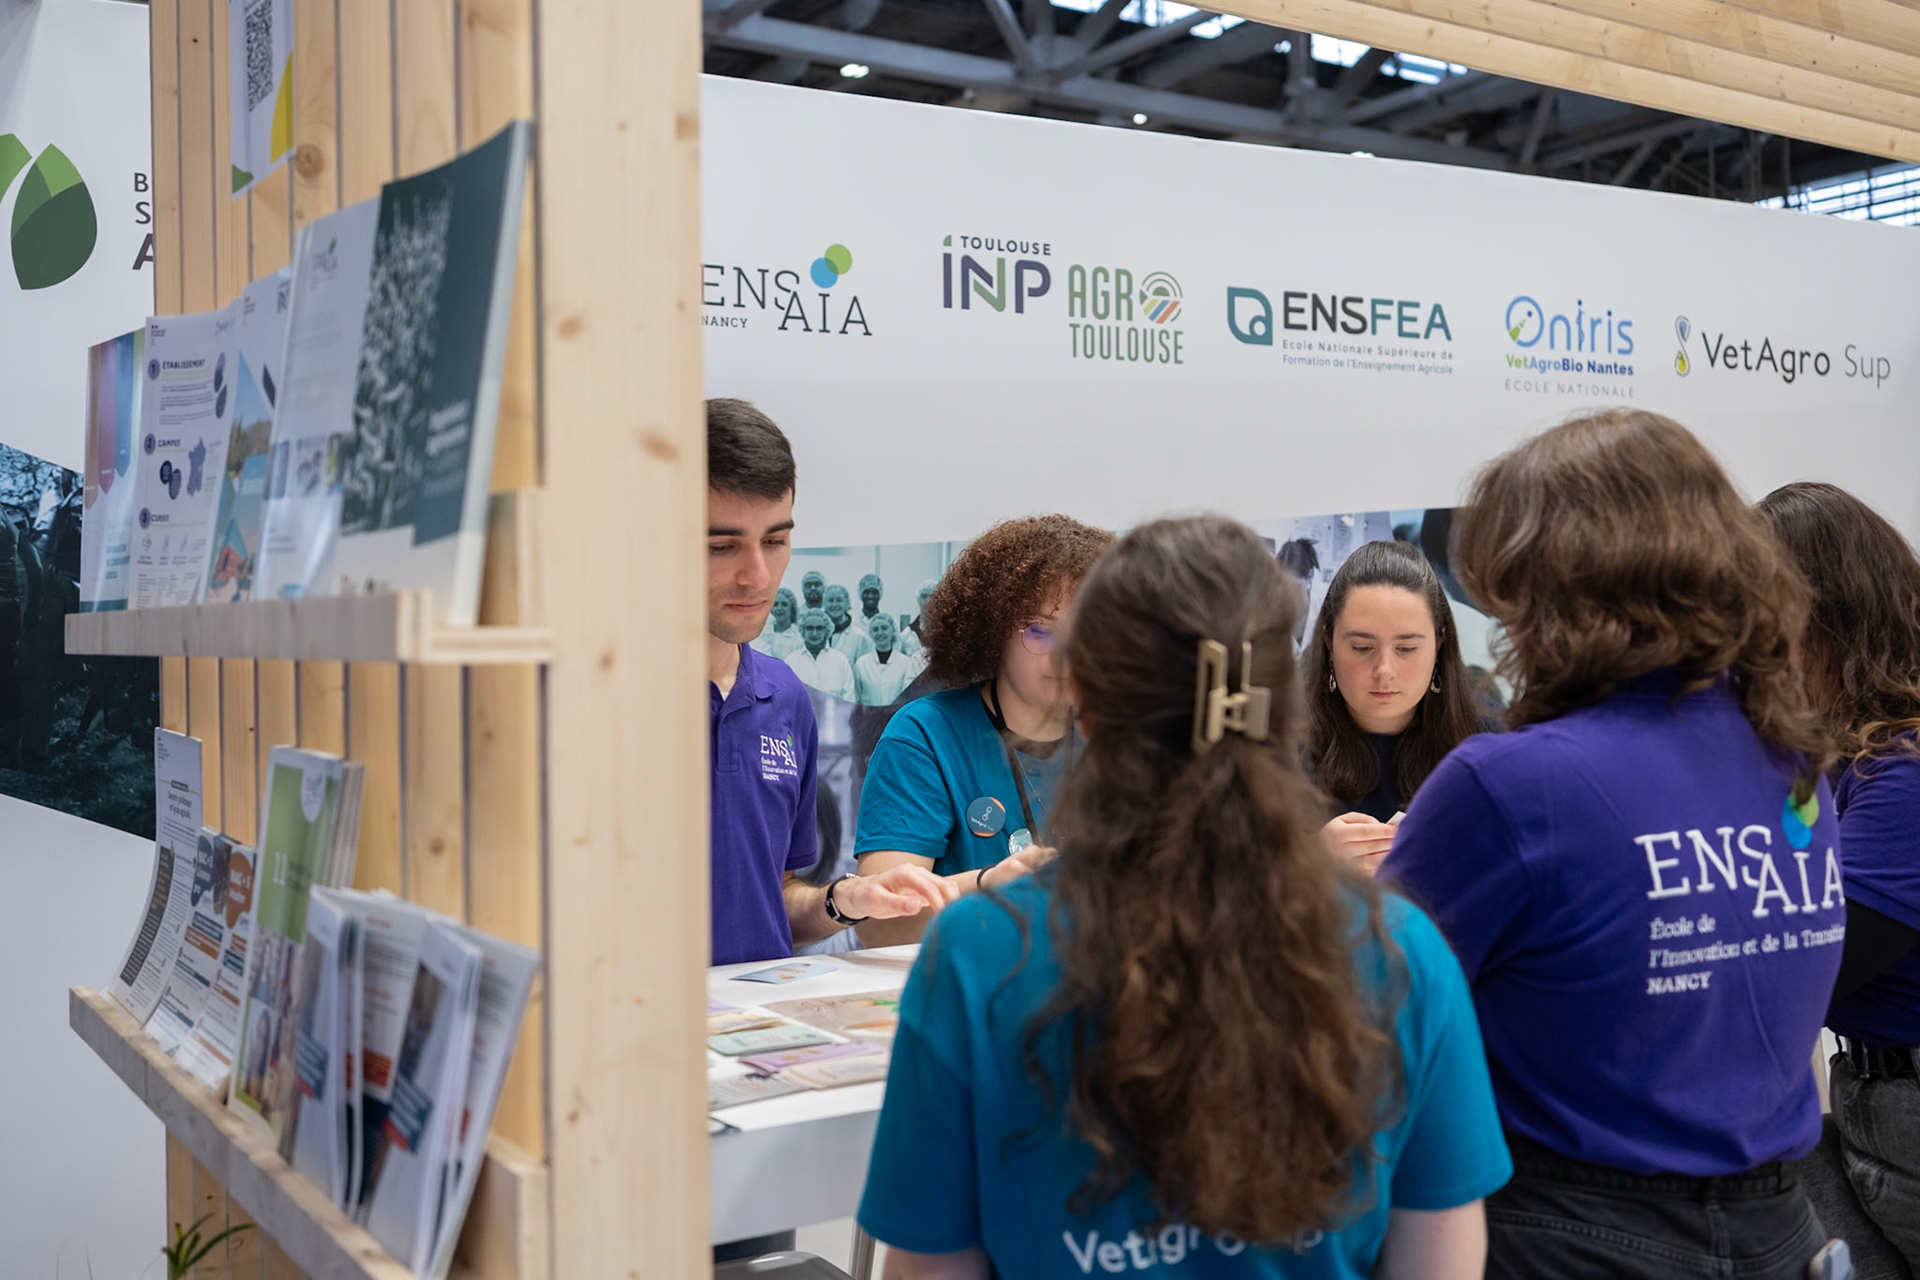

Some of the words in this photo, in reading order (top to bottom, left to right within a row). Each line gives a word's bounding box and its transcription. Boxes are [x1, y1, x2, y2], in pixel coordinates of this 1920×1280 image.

[960, 235, 1052, 256] TOULOUSE
[701, 315, 748, 329] NANCY
[1283, 290, 1453, 342] ENSFEA
[1505, 295, 1635, 356] Oniris
[1068, 322, 1184, 365] TOULOUSE
[1318, 341, 1373, 356] Nationale
[1377, 345, 1437, 361] Supérieure
[1441, 348, 1454, 361] de
[1282, 353, 1331, 368] Formation
[1333, 357, 1345, 368] de
[1347, 358, 1416, 374] l'Enseignement
[1418, 363, 1454, 376] Agricole
[1505, 353, 1583, 374] VetAgroBio
[1587, 359, 1634, 376] Nantes
[1701, 331, 1831, 384] VetAgro
[1844, 343, 1892, 389] Sup
[1557, 383, 1635, 399] NATIONALE
[1649, 916, 1694, 940] École
[1697, 913, 1717, 934] de
[1649, 940, 1740, 969] l'Innovation
[1742, 938, 1758, 955] et
[1760, 933, 1780, 952] de
[1783, 931, 1799, 950] la
[1646, 970, 1713, 996] NANCY
